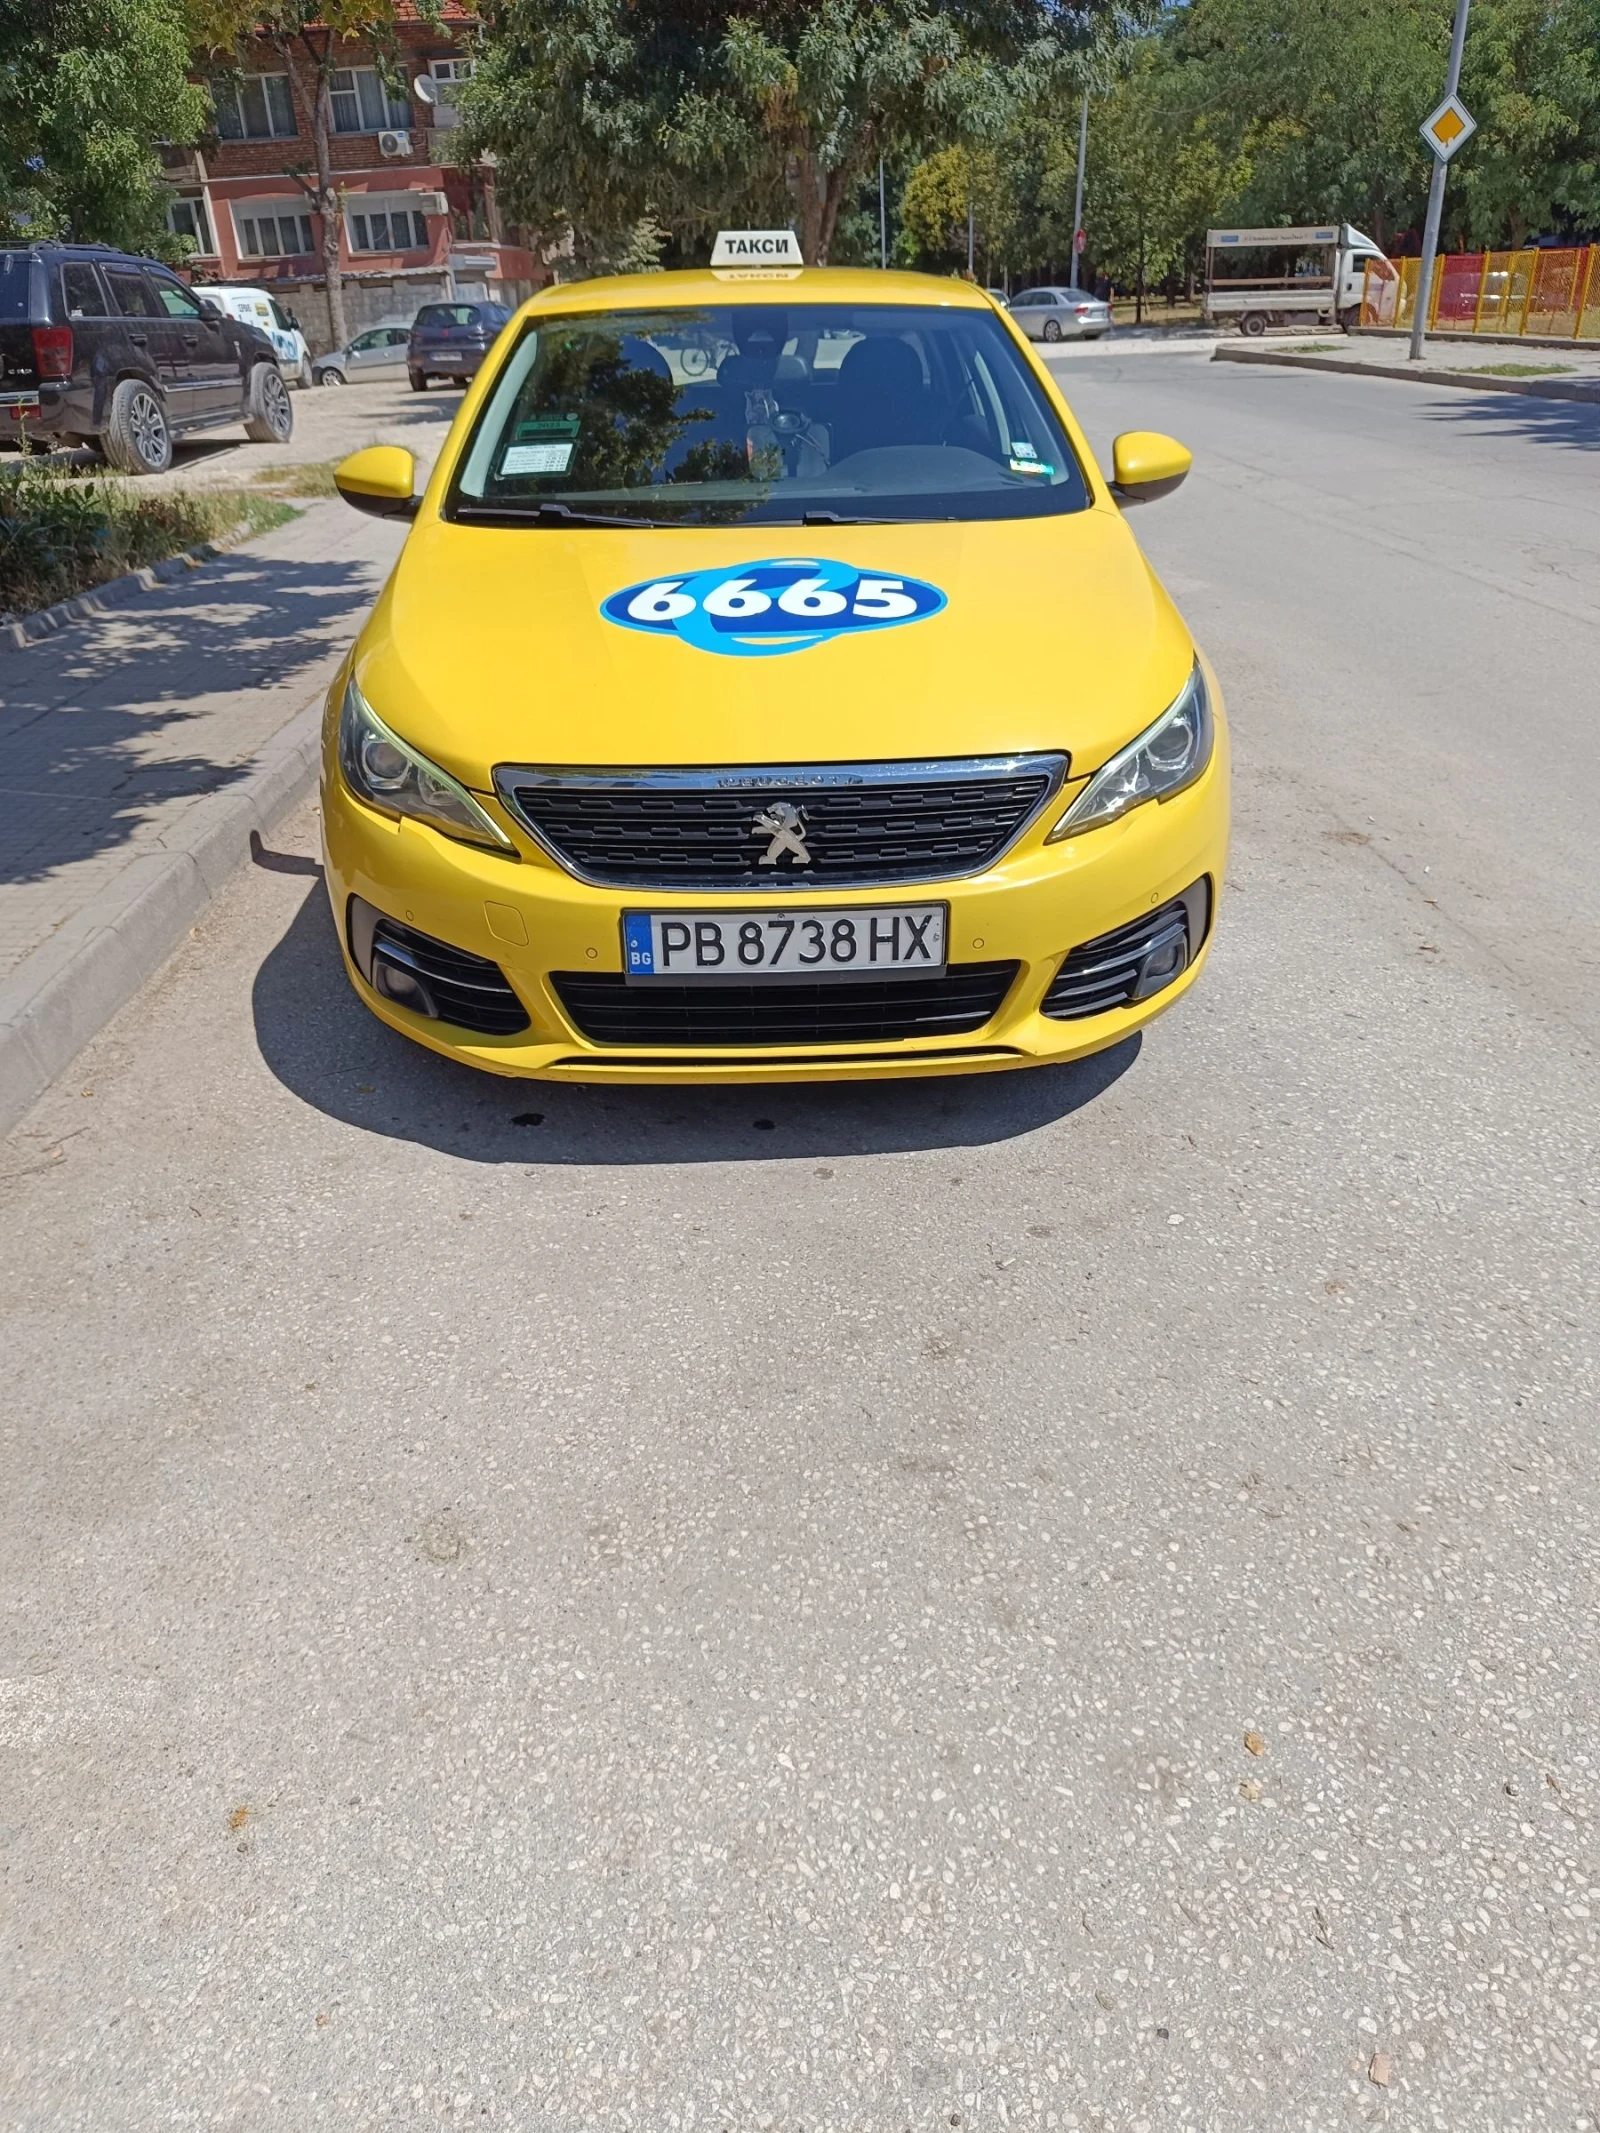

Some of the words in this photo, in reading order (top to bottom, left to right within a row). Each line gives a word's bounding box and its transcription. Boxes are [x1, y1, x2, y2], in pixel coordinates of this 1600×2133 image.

[725, 239, 788, 254] ТАКСИ
[628, 579, 918, 621] 6665
[717, 775, 840, 787] PEUGEOT
[661, 922, 725, 966] PB
[738, 919, 857, 965] 8738
[869, 915, 932, 962] HX
[631, 952, 651, 965] BG
